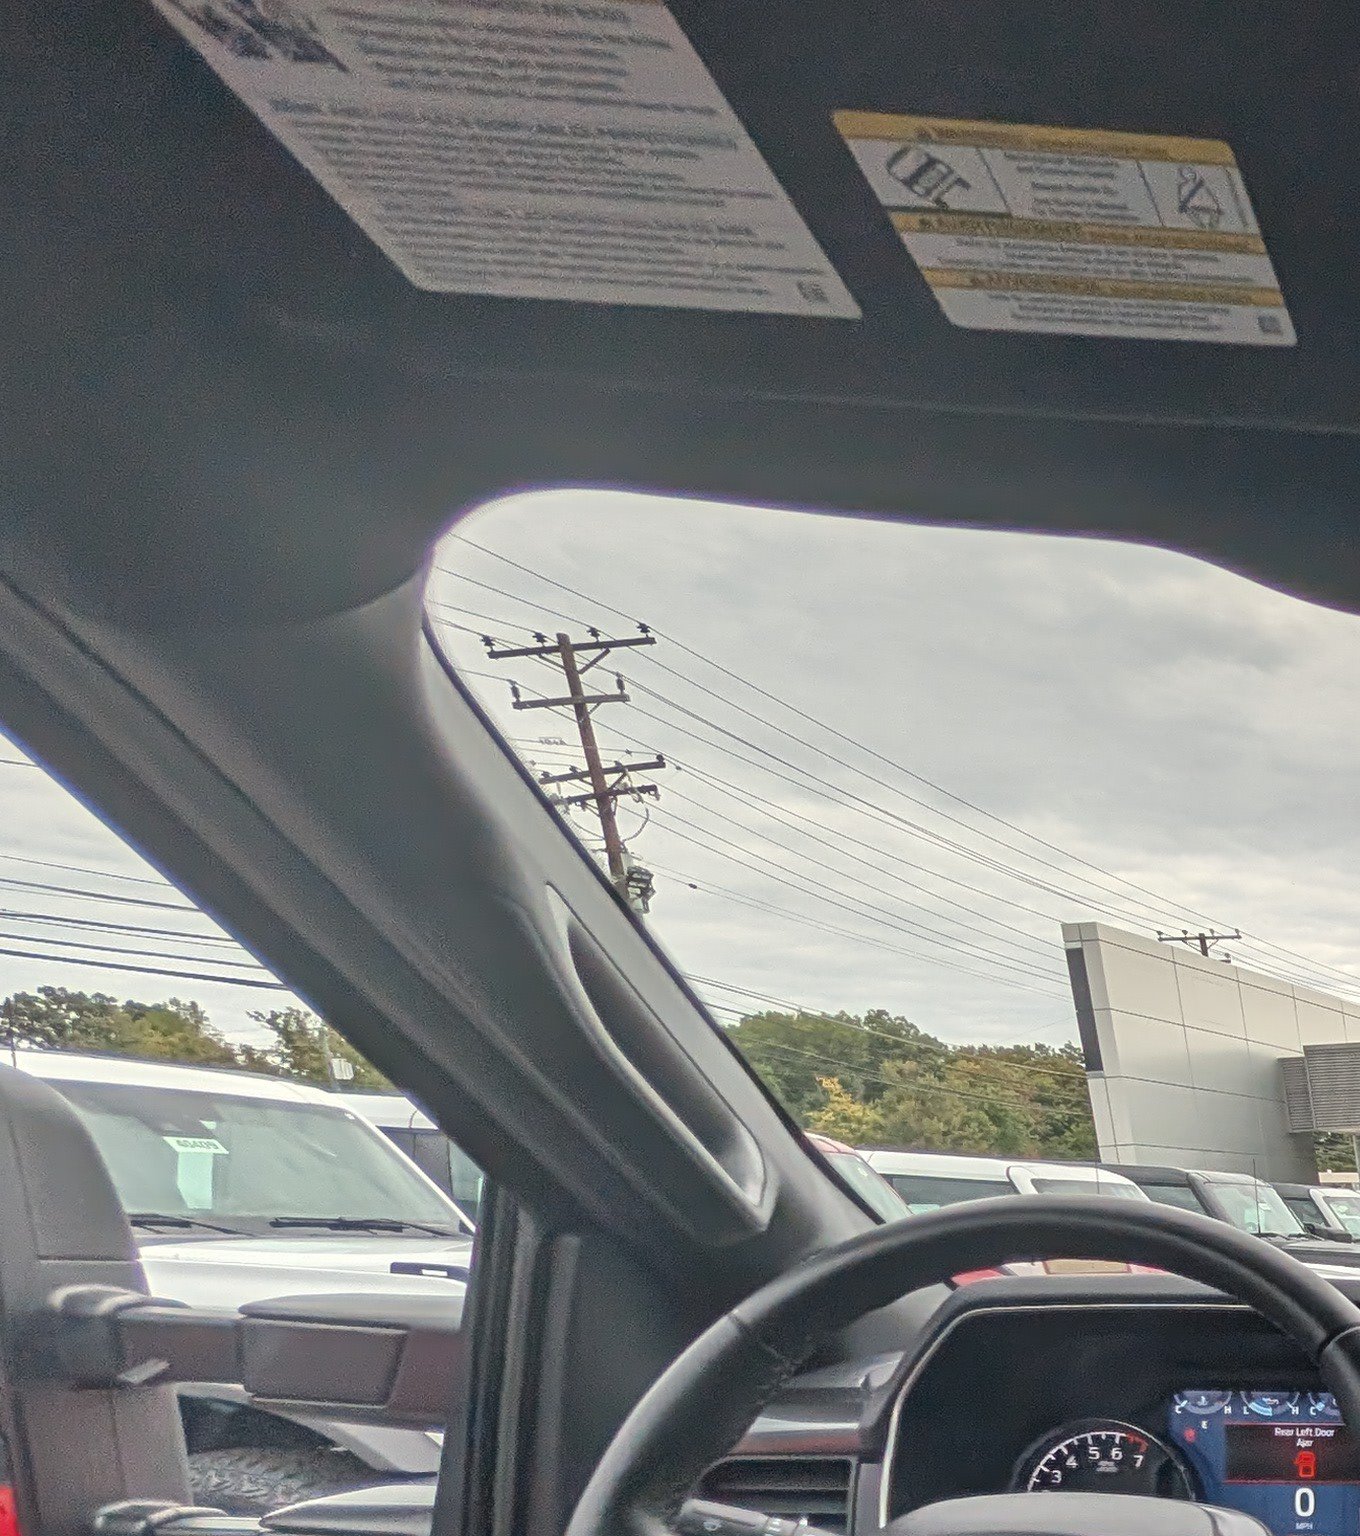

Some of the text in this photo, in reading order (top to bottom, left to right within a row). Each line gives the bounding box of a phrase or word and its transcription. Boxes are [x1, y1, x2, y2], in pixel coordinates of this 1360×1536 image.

[1315, 1427, 1335, 1437] Door
[1087, 1446, 1101, 1461] 5
[1110, 1447, 1124, 1461] 6
[1065, 1454, 1079, 1469] 4
[1132, 1454, 1144, 1469] 7
[1051, 1469, 1063, 1484] 3
[1294, 1486, 1316, 1518] 0
